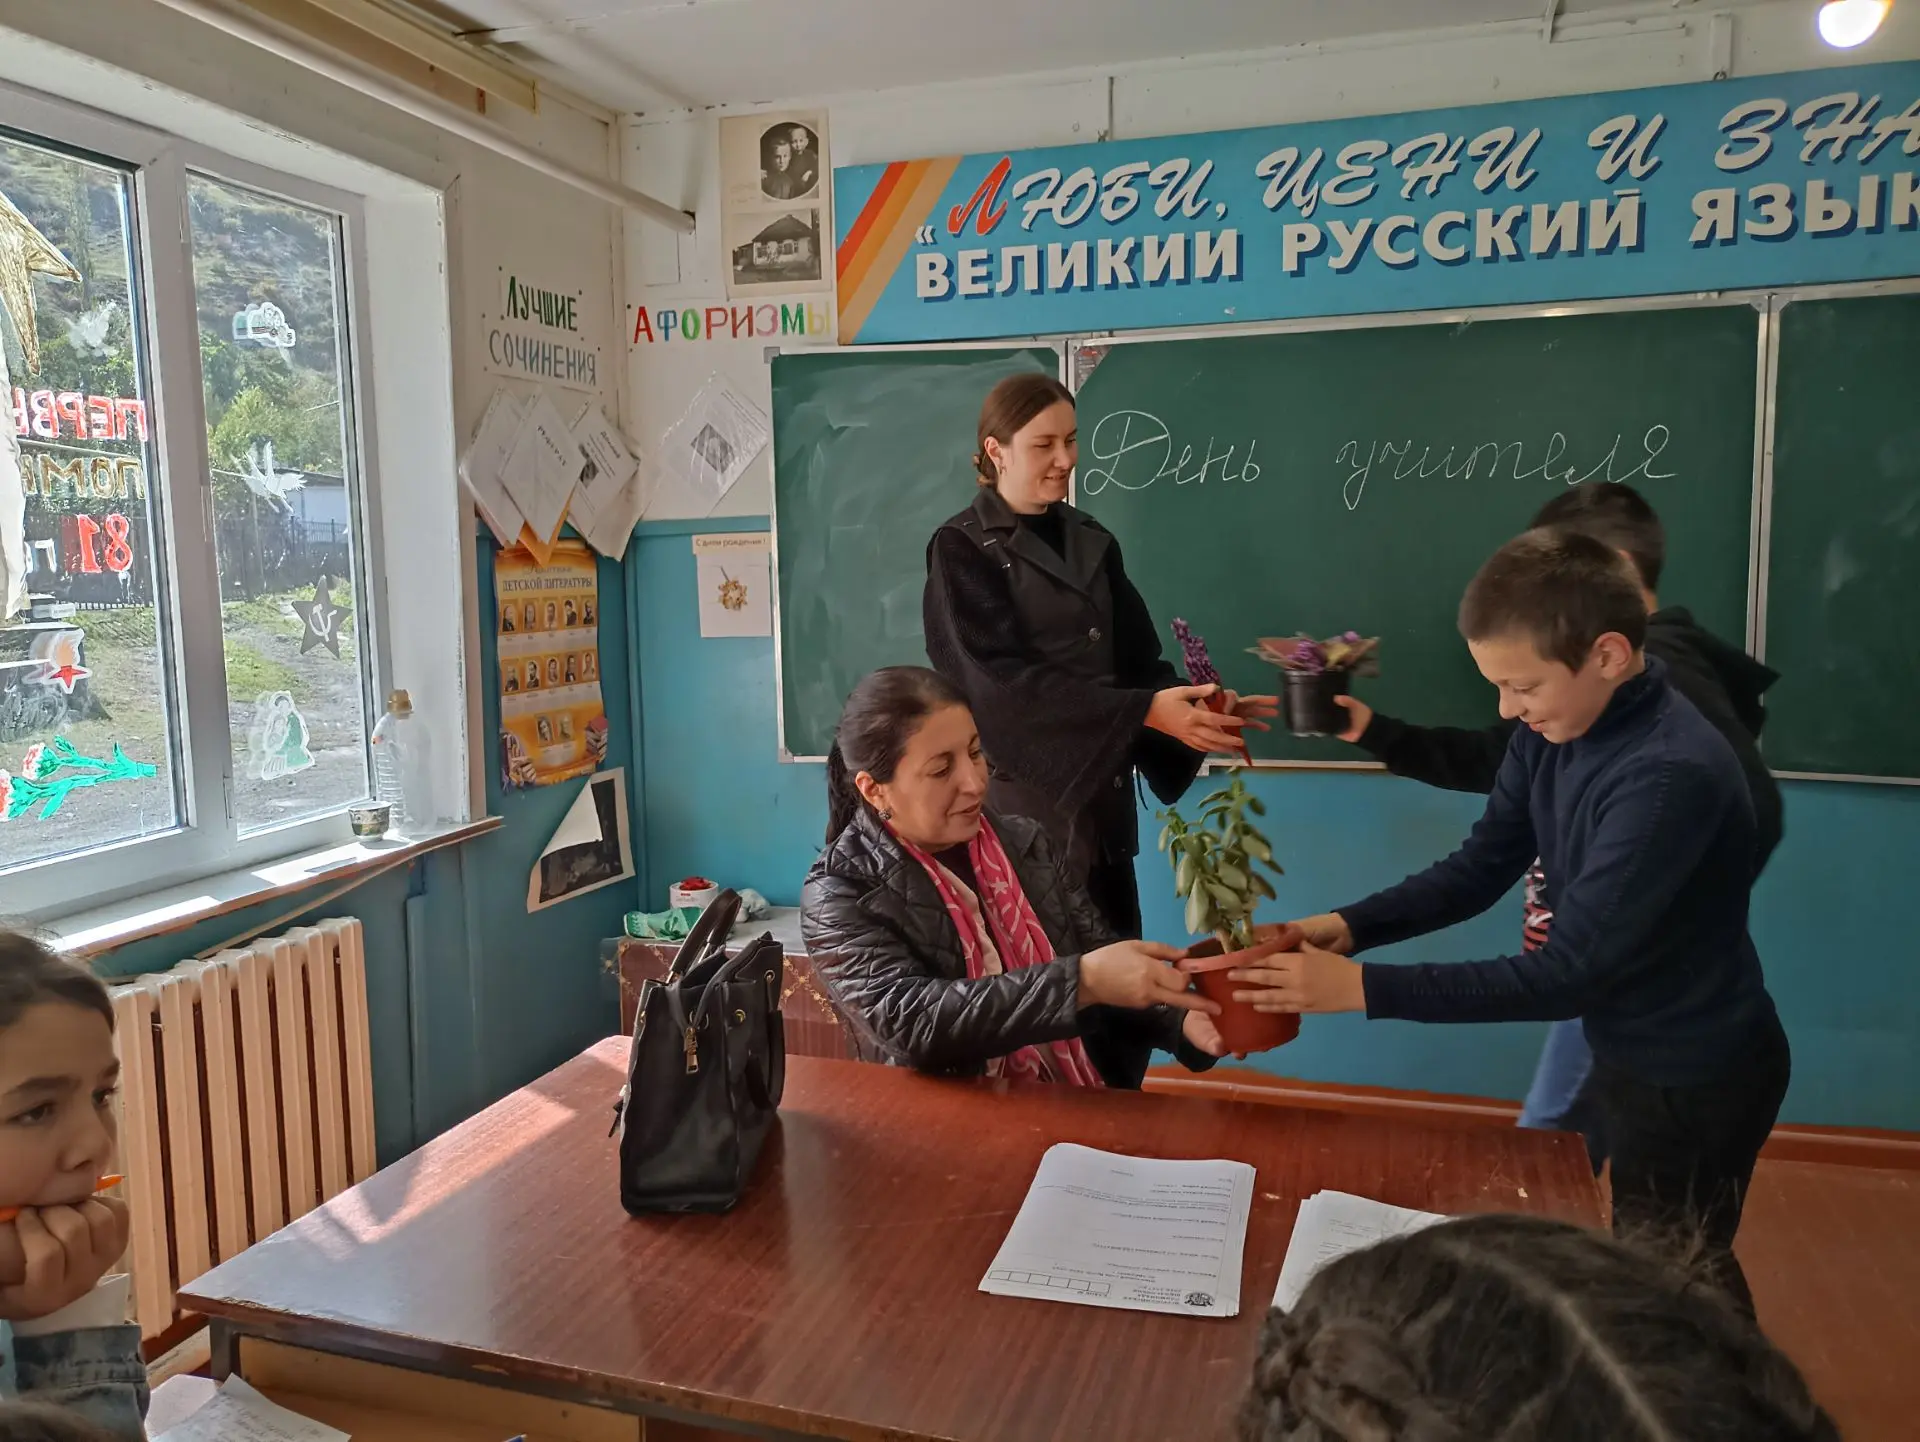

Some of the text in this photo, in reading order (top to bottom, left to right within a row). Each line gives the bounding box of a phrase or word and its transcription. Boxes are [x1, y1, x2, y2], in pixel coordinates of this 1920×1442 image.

[1255, 125, 1544, 218] ЦЕНИ
[1587, 112, 1669, 182] И
[1282, 188, 1646, 277] РУССКИЙ
[506, 275, 579, 333] ЛУЧШИЕ
[633, 302, 831, 343] АФОРИЗМЫ
[489, 329, 597, 387] СОЧИНЕНИЯ
[1083, 410, 1677, 510] День учителя
[503, 577, 593, 592] ДЕТСКОЙ ЛИТЕРАТУРЫ
